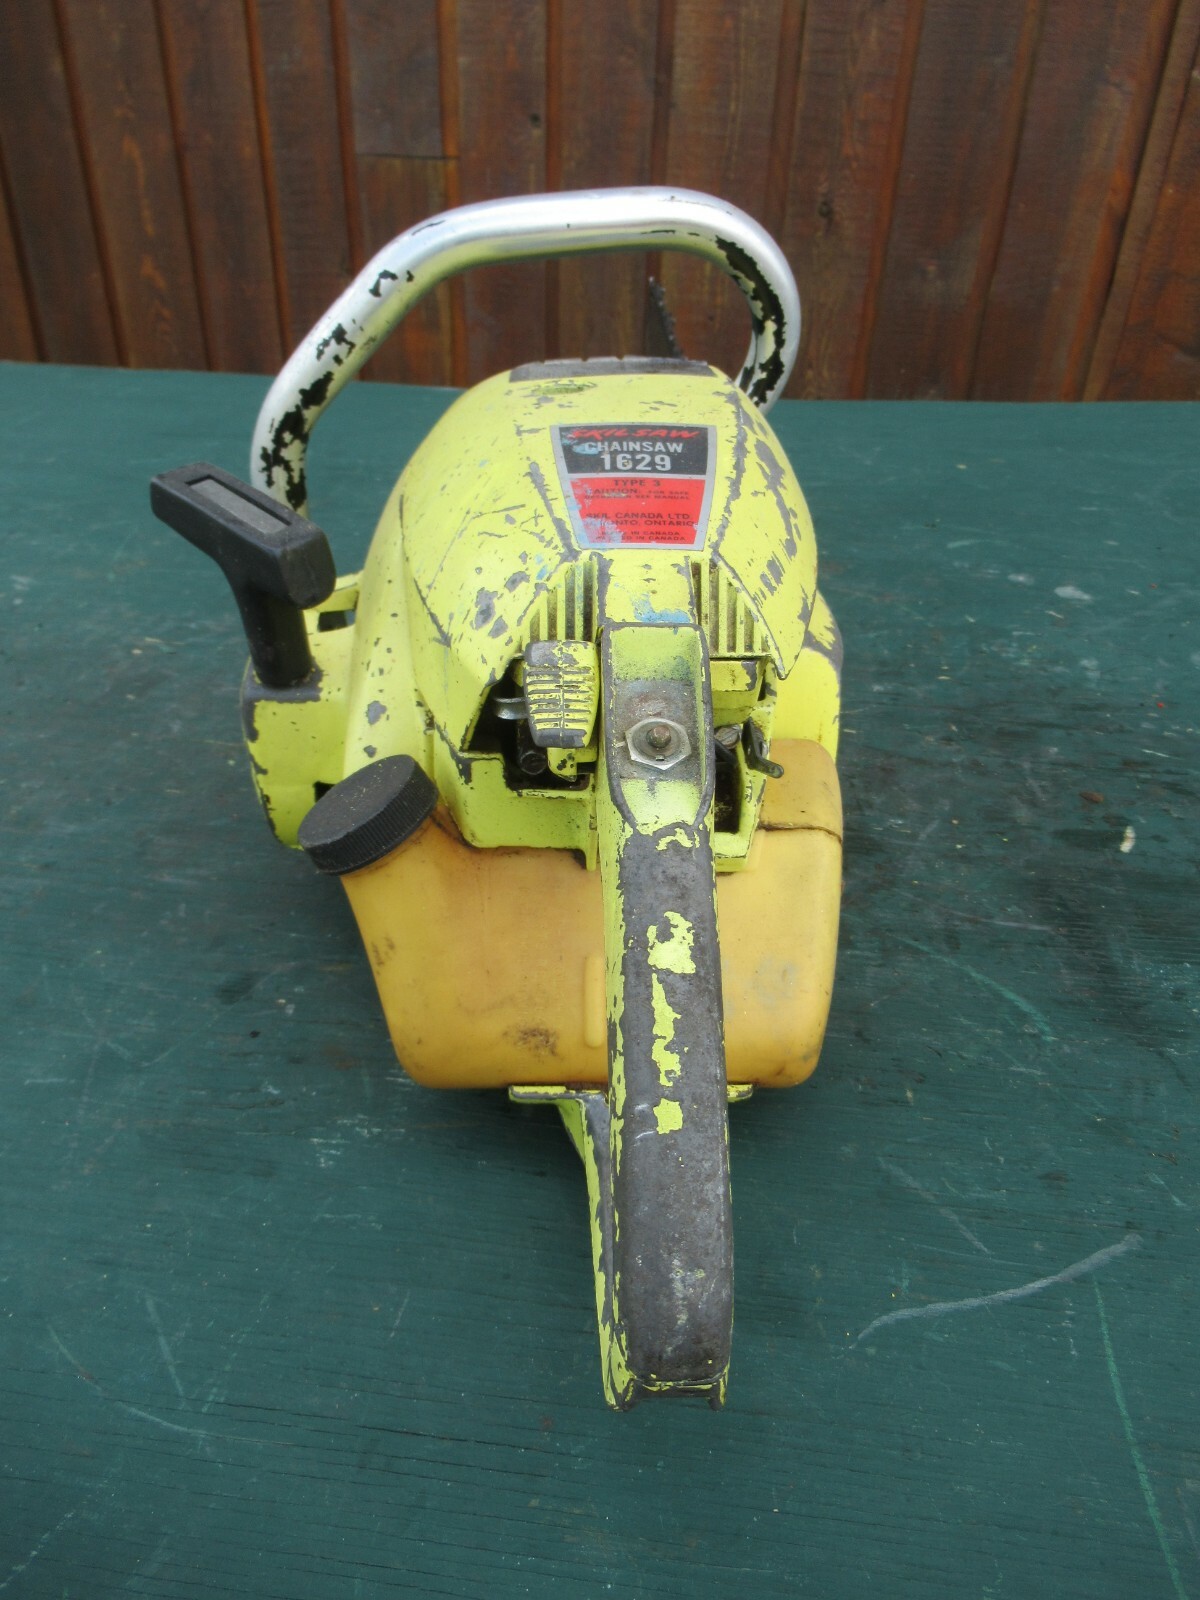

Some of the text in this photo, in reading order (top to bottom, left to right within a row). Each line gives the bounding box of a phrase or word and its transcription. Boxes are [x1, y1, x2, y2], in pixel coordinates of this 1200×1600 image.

[632, 428, 700, 439] SAW
[584, 441, 683, 453] CHAINSAW
[600, 453, 672, 472] 1629
[614, 479, 646, 487] TYPE
[644, 519, 695, 527] ONTARIO
